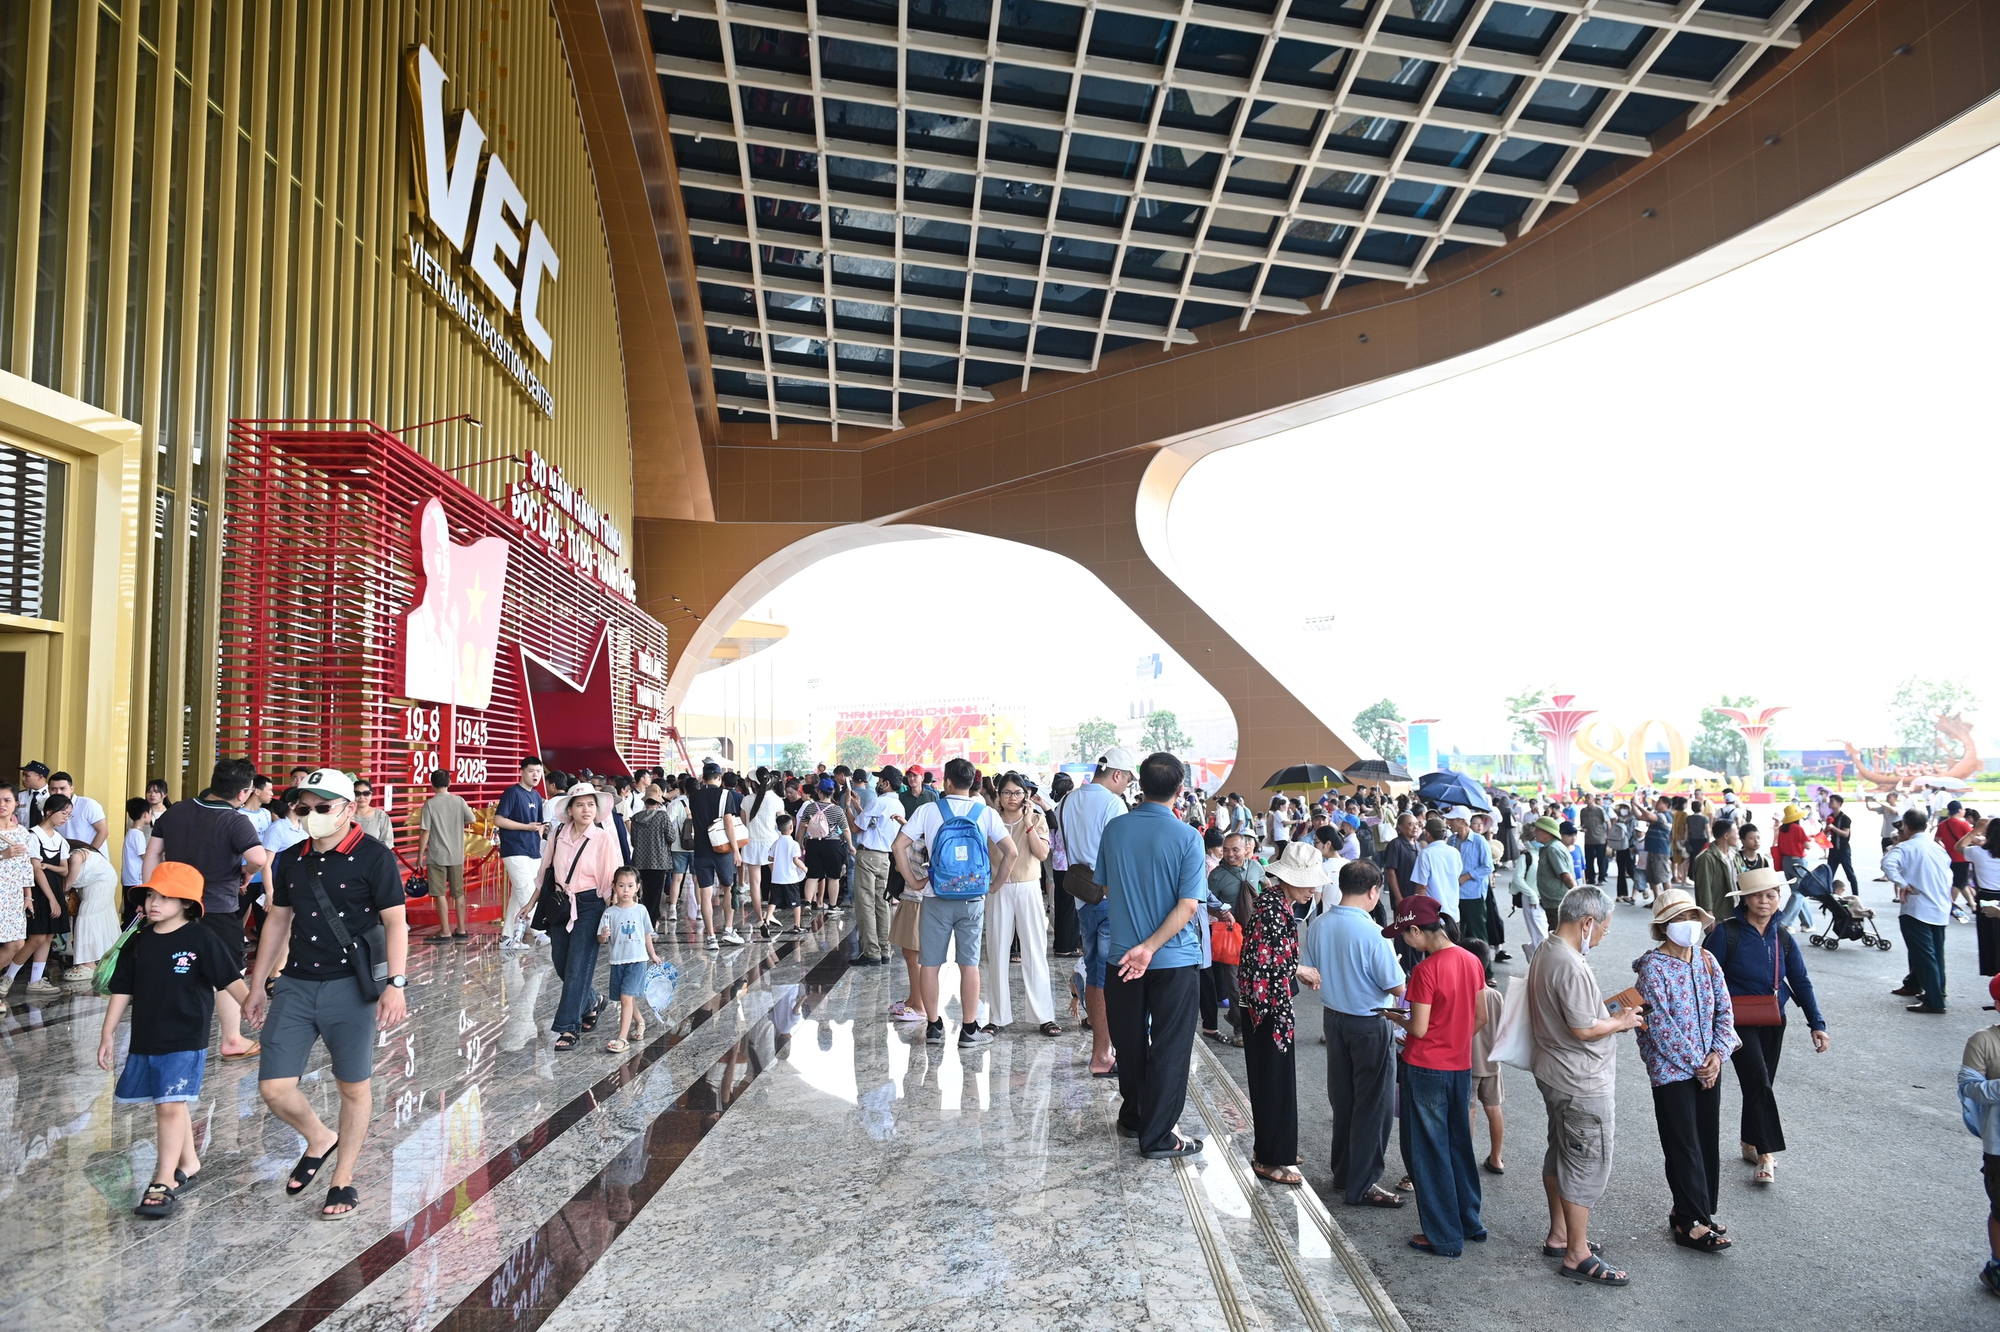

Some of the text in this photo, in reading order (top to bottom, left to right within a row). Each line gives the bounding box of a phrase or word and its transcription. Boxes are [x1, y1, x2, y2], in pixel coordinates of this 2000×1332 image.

[416, 43, 560, 364] VEC
[408, 234, 554, 418] VIETNAM EXPOSITION CENTER
[531, 450, 547, 490] 80
[405, 706, 440, 742] 19-8
[456, 719, 488, 746] 1945
[413, 750, 439, 784] 2-9
[456, 757, 488, 784] 2025
[1576, 720, 1690, 793] 80
